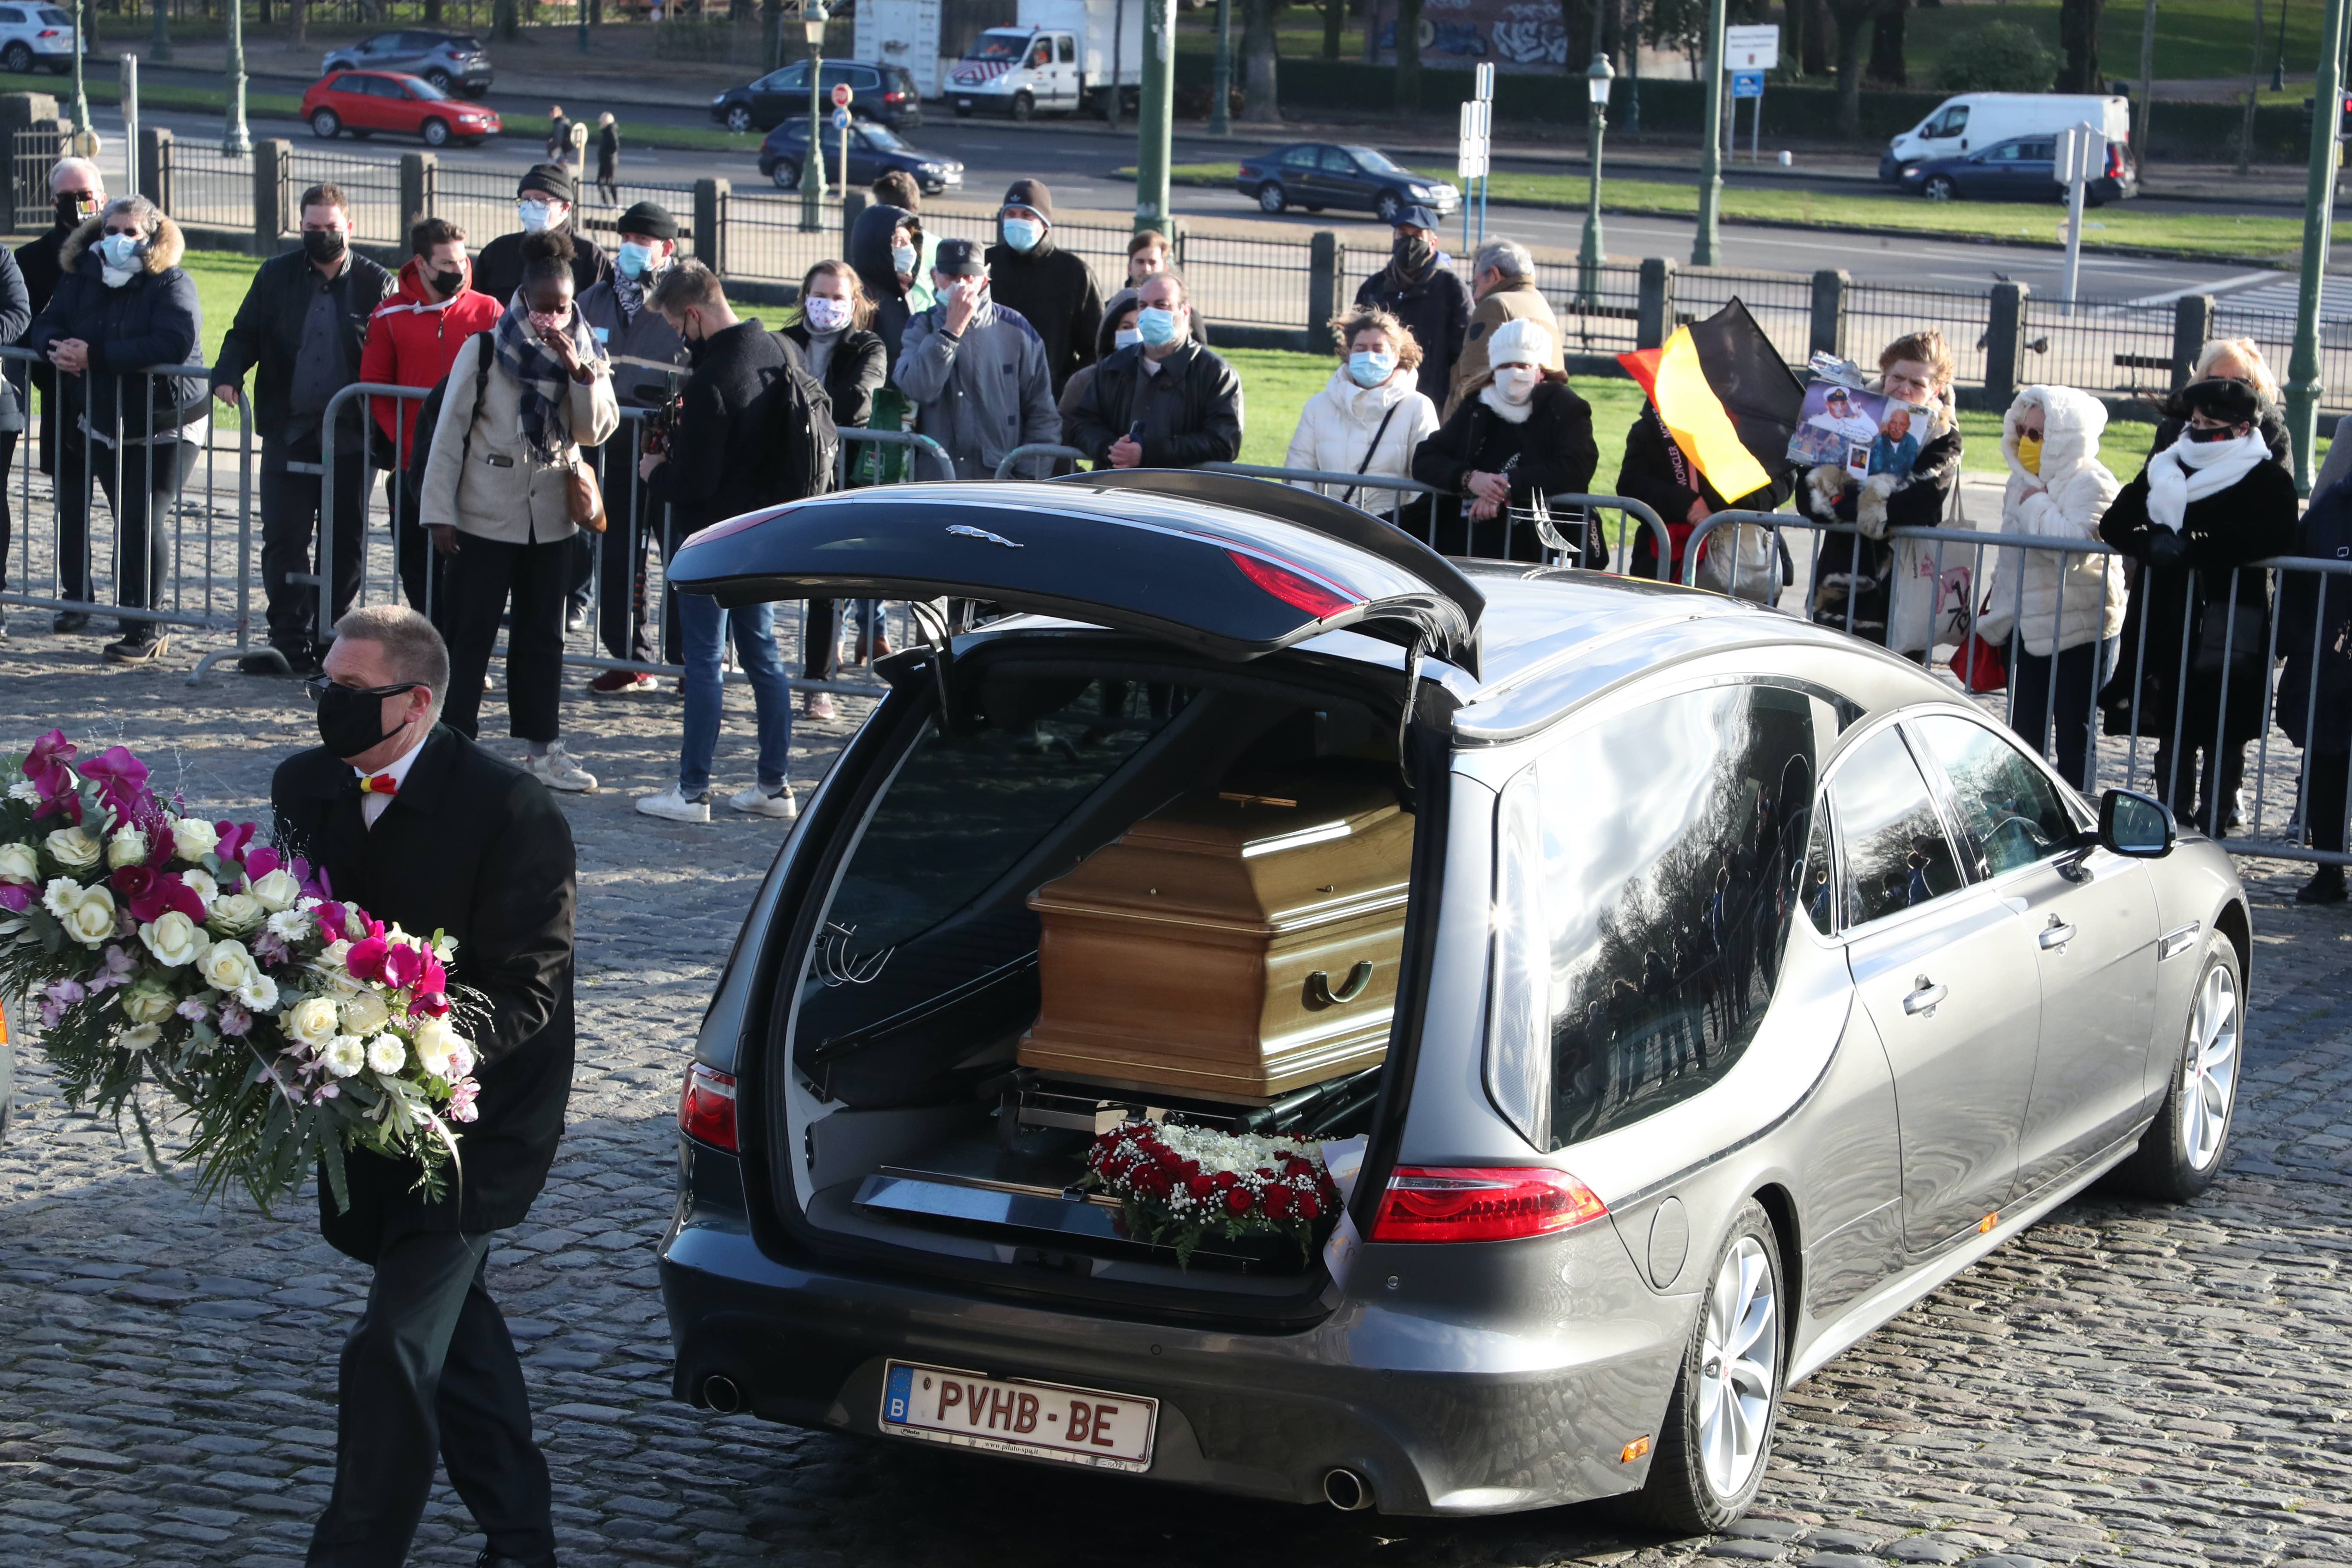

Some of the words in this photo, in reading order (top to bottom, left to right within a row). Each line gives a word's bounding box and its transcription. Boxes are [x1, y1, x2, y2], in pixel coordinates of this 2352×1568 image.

[1590, 520, 1600, 557] adidas
[1692, 1276, 1715, 1375] UNIROYAL
[890, 1398, 904, 1418] B
[985, 1441, 1039, 1455] www.pilato-spa.it
